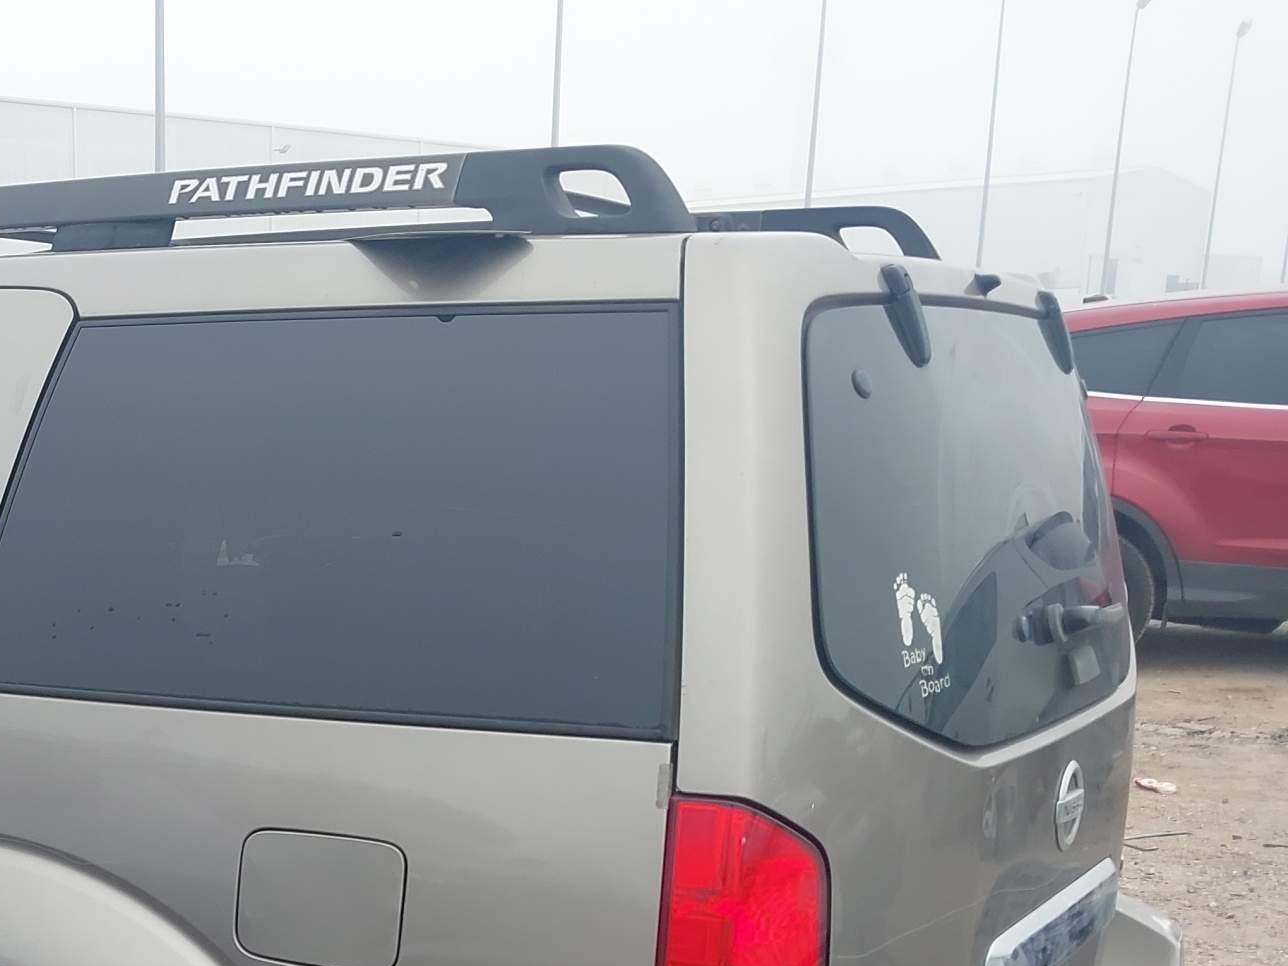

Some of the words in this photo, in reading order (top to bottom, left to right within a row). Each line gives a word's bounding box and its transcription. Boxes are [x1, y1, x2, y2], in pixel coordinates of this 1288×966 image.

[168, 162, 448, 204] PATHFINDER
[901, 647, 926, 668] Baby
[919, 672, 951, 698] Board
